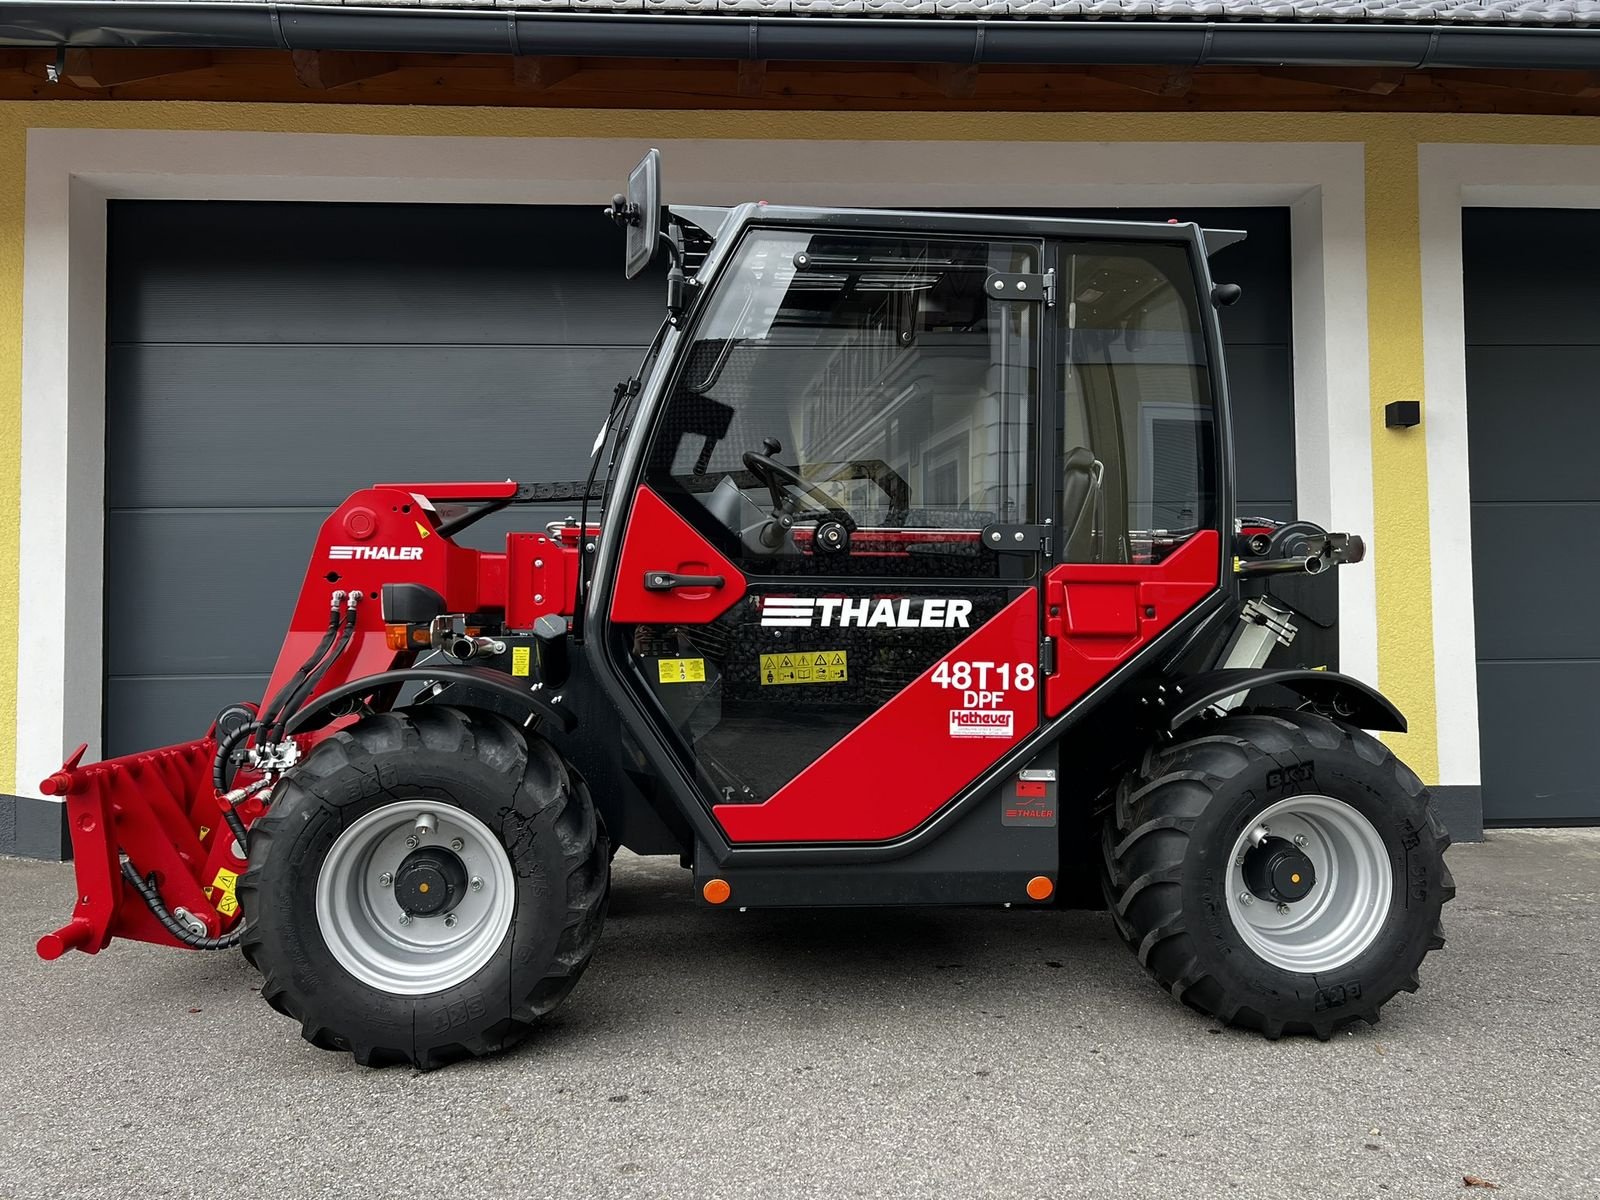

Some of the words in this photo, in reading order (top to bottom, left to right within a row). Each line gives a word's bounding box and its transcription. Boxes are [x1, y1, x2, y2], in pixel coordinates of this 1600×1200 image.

[353, 546, 424, 560] THALER
[815, 598, 973, 628] THALER
[931, 661, 1035, 692] 48T18
[963, 690, 1005, 709] DPF
[1017, 809, 1053, 817] THALER
